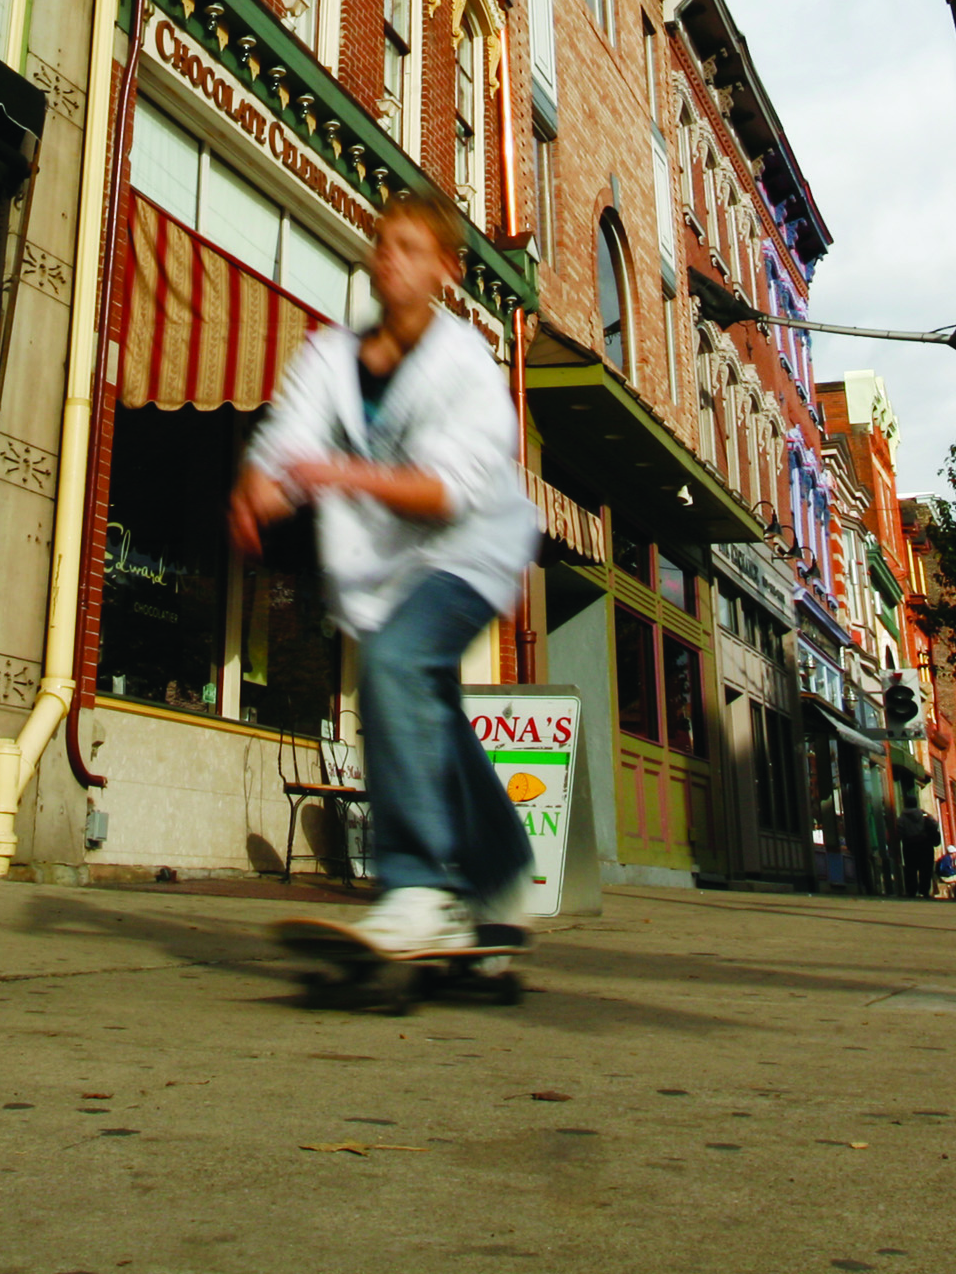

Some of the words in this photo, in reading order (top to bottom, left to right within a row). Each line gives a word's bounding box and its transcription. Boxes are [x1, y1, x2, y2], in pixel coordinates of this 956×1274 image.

[155, 20, 268, 145] CHOCOLATE
[133, 601, 180, 625] CHOCOLATIER
[470, 715, 572, 744] ONA'S
